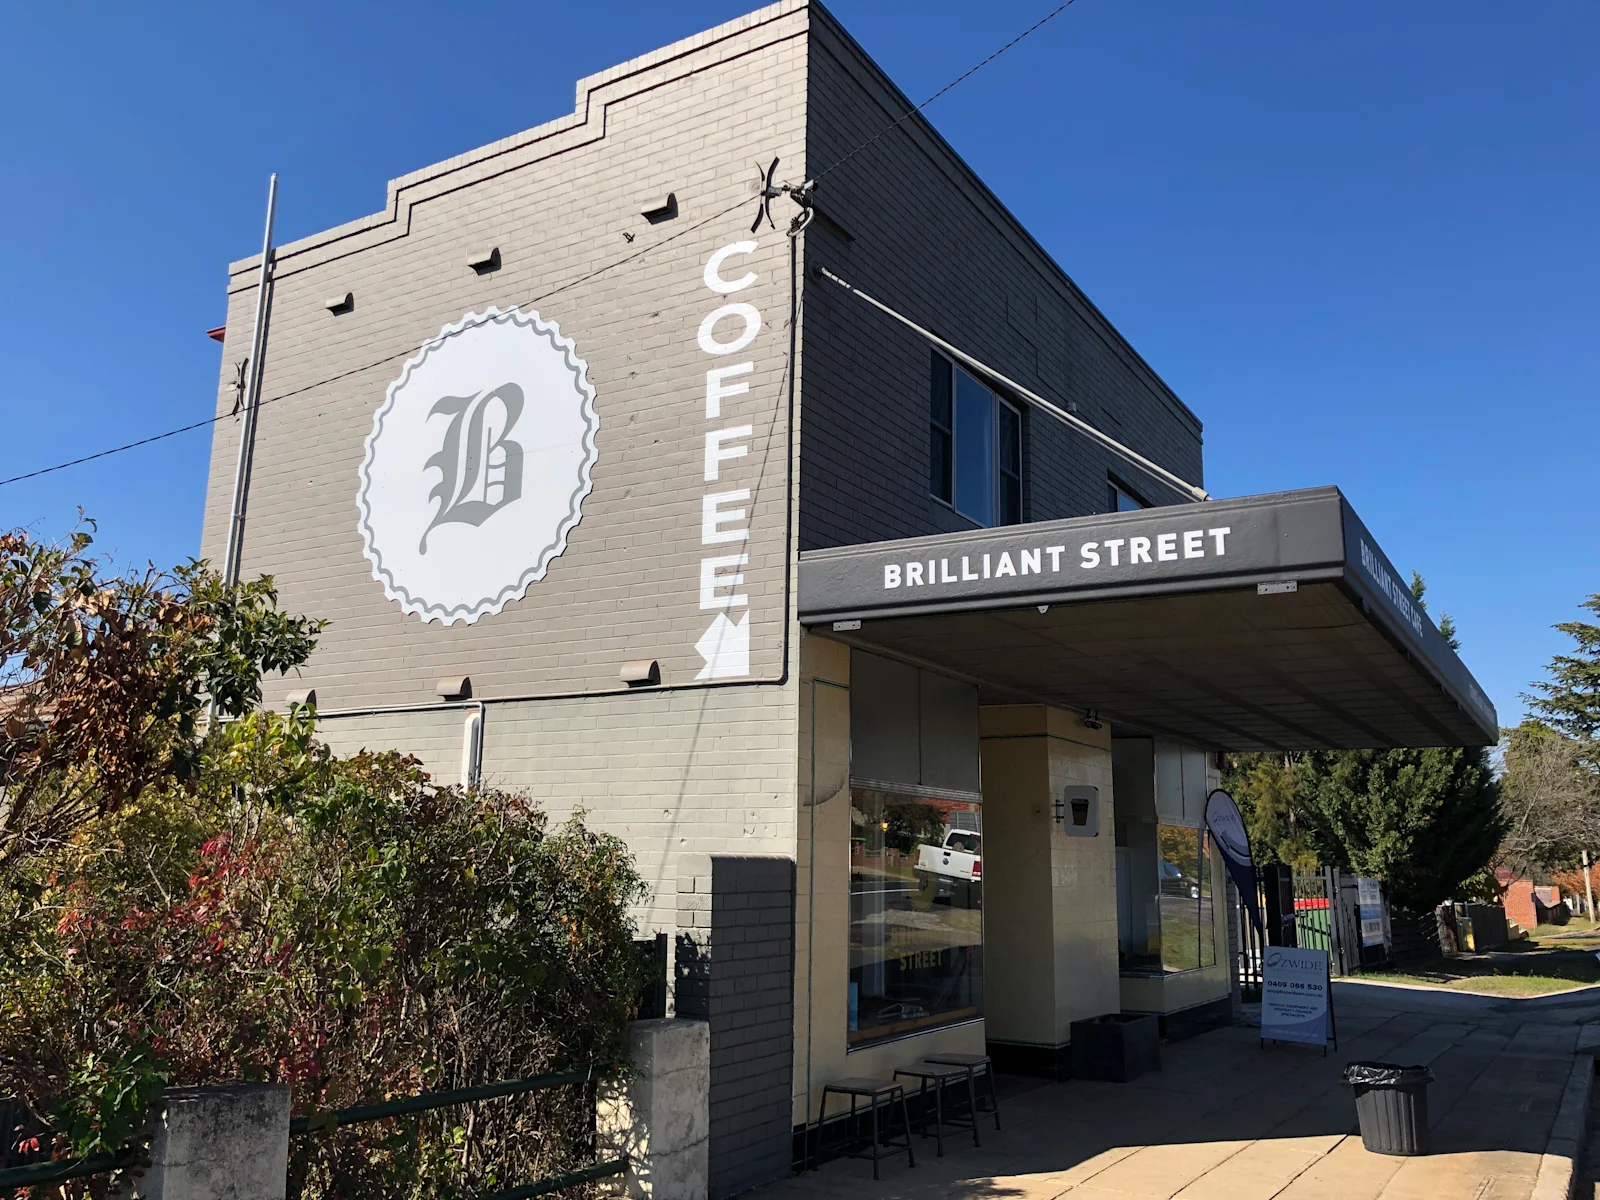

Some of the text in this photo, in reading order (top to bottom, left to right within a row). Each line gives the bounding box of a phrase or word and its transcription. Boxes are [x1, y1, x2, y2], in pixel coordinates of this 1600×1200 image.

[697, 240, 761, 610] COFFEE
[419, 382, 525, 556] B
[883, 526, 1231, 590] BRILLIANT STREET
[1360, 537, 1392, 600] BRILLIANT
[1391, 580, 1411, 623] STREET
[1213, 811, 1237, 823] OZWIDE
[899, 948, 942, 971] STREET
[1266, 952, 1323, 971] OZWIDE
[1267, 980, 1287, 988] 0409
[1307, 983, 1323, 991] 530
